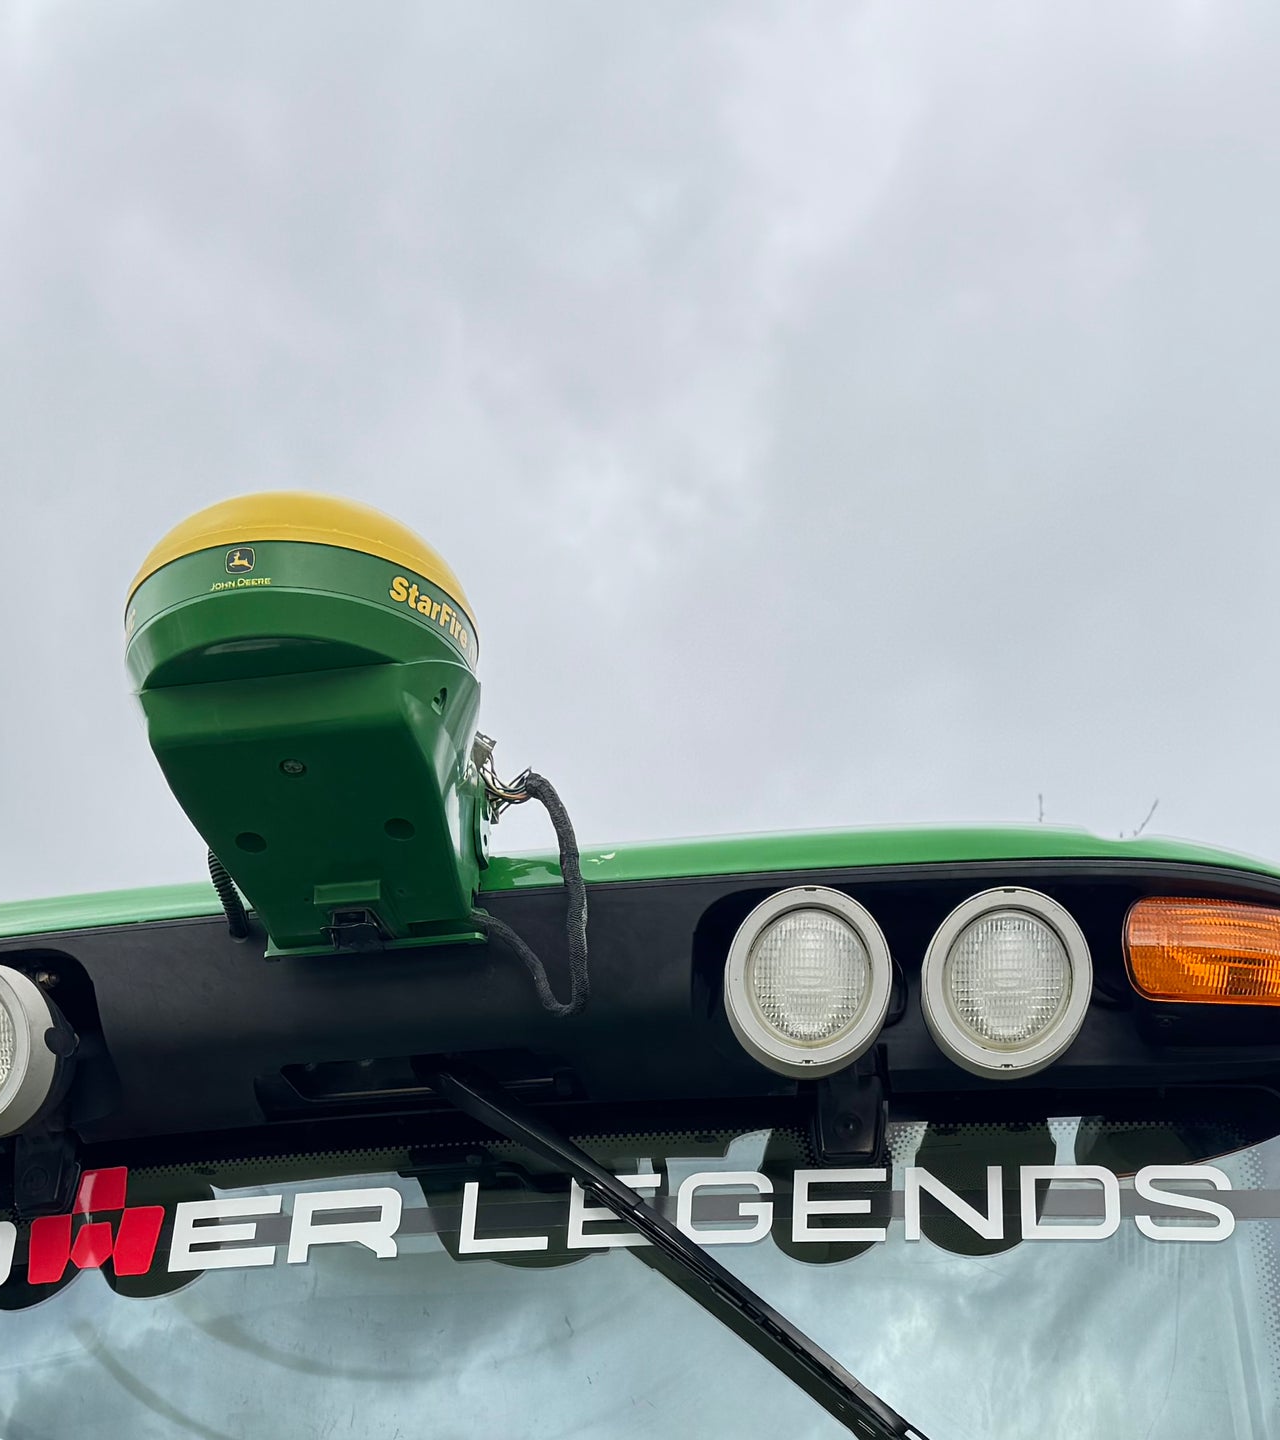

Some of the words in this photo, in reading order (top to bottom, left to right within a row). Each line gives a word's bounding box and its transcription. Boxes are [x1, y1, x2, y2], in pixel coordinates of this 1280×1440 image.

[210, 581, 236, 591] JOHN
[238, 578, 272, 587] DEERE
[389, 575, 468, 649] StarFire
[458, 1164, 1237, 1254] LEGENDS
